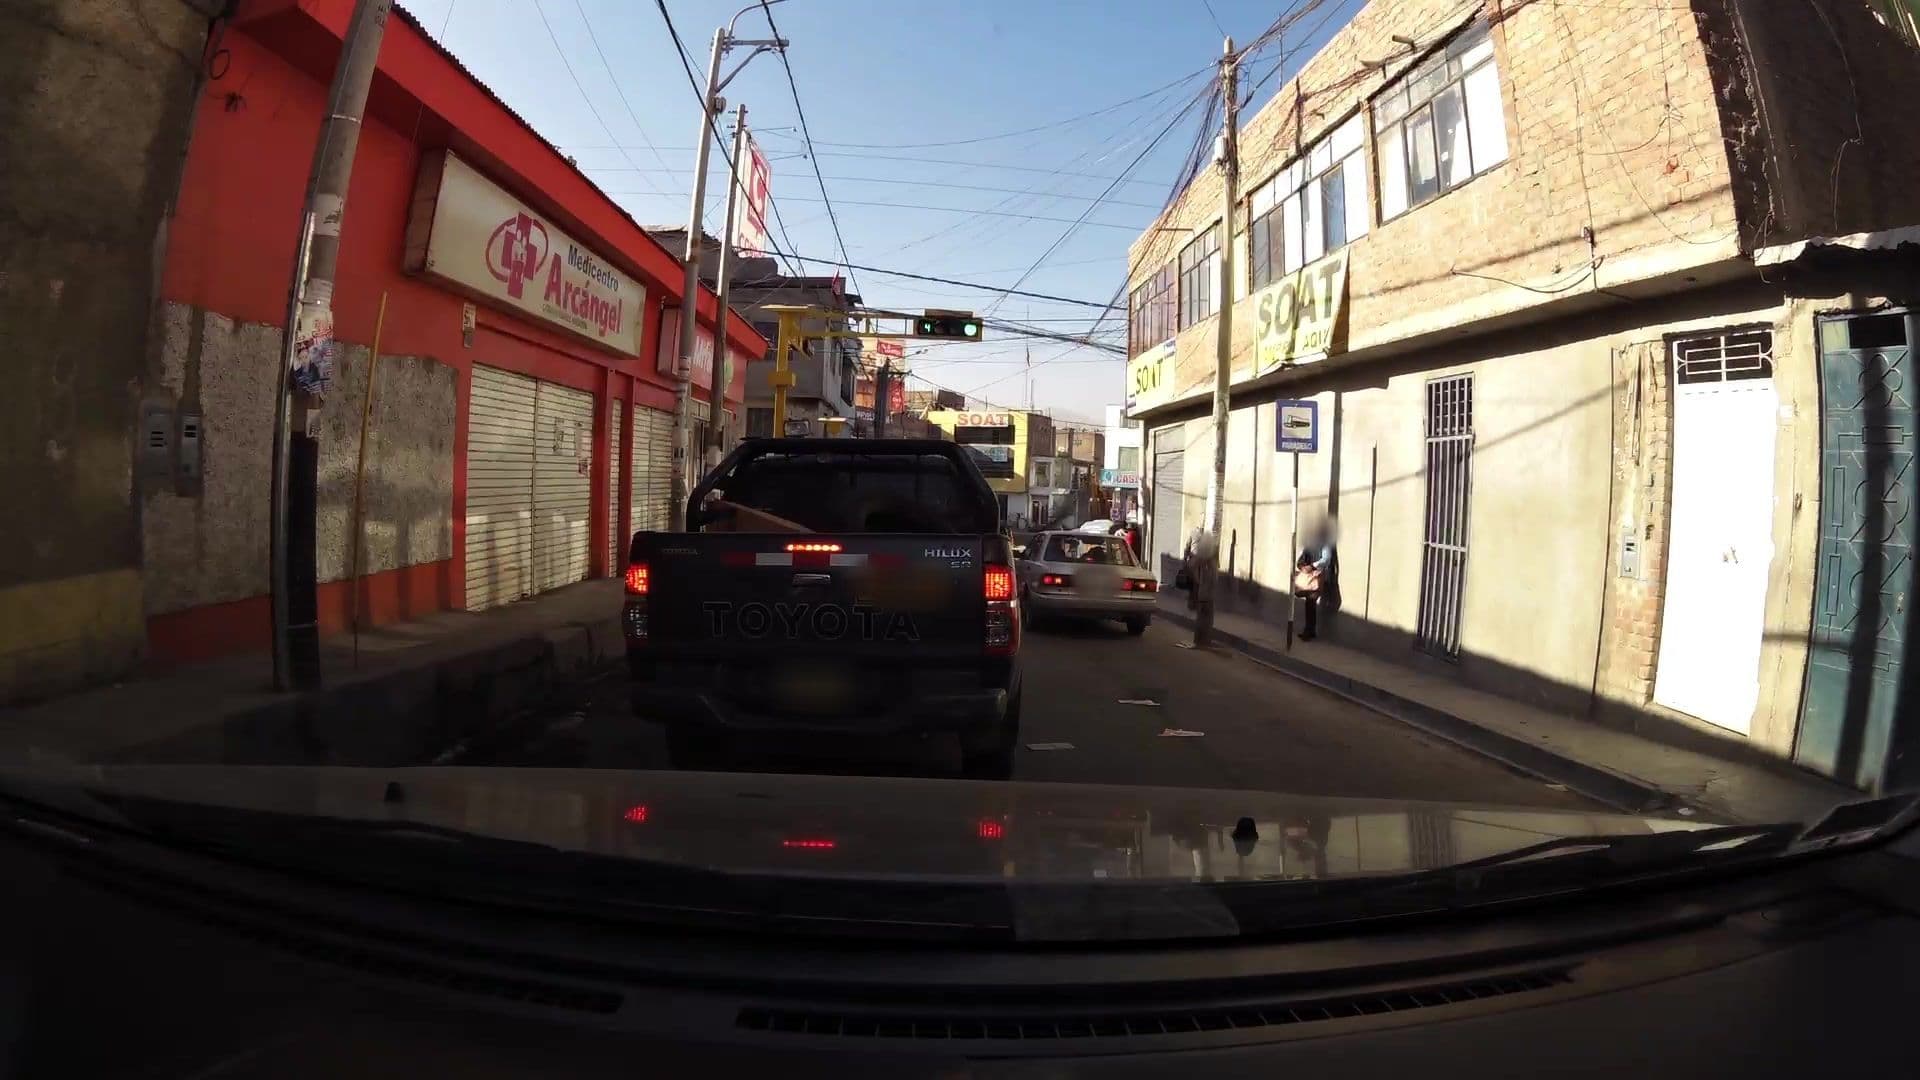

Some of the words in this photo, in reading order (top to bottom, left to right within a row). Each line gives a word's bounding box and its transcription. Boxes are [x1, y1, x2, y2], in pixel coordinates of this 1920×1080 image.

[568, 244, 619, 292] Medicentro
[544, 251, 622, 337] Arcángel
[1258, 259, 1341, 340] SOAT
[924, 323, 931, 332] 4
[1135, 357, 1164, 395] SOAT
[957, 412, 1005, 426] SOAT
[924, 549, 971, 558] HILUX
[702, 601, 920, 640] TOYOTA
